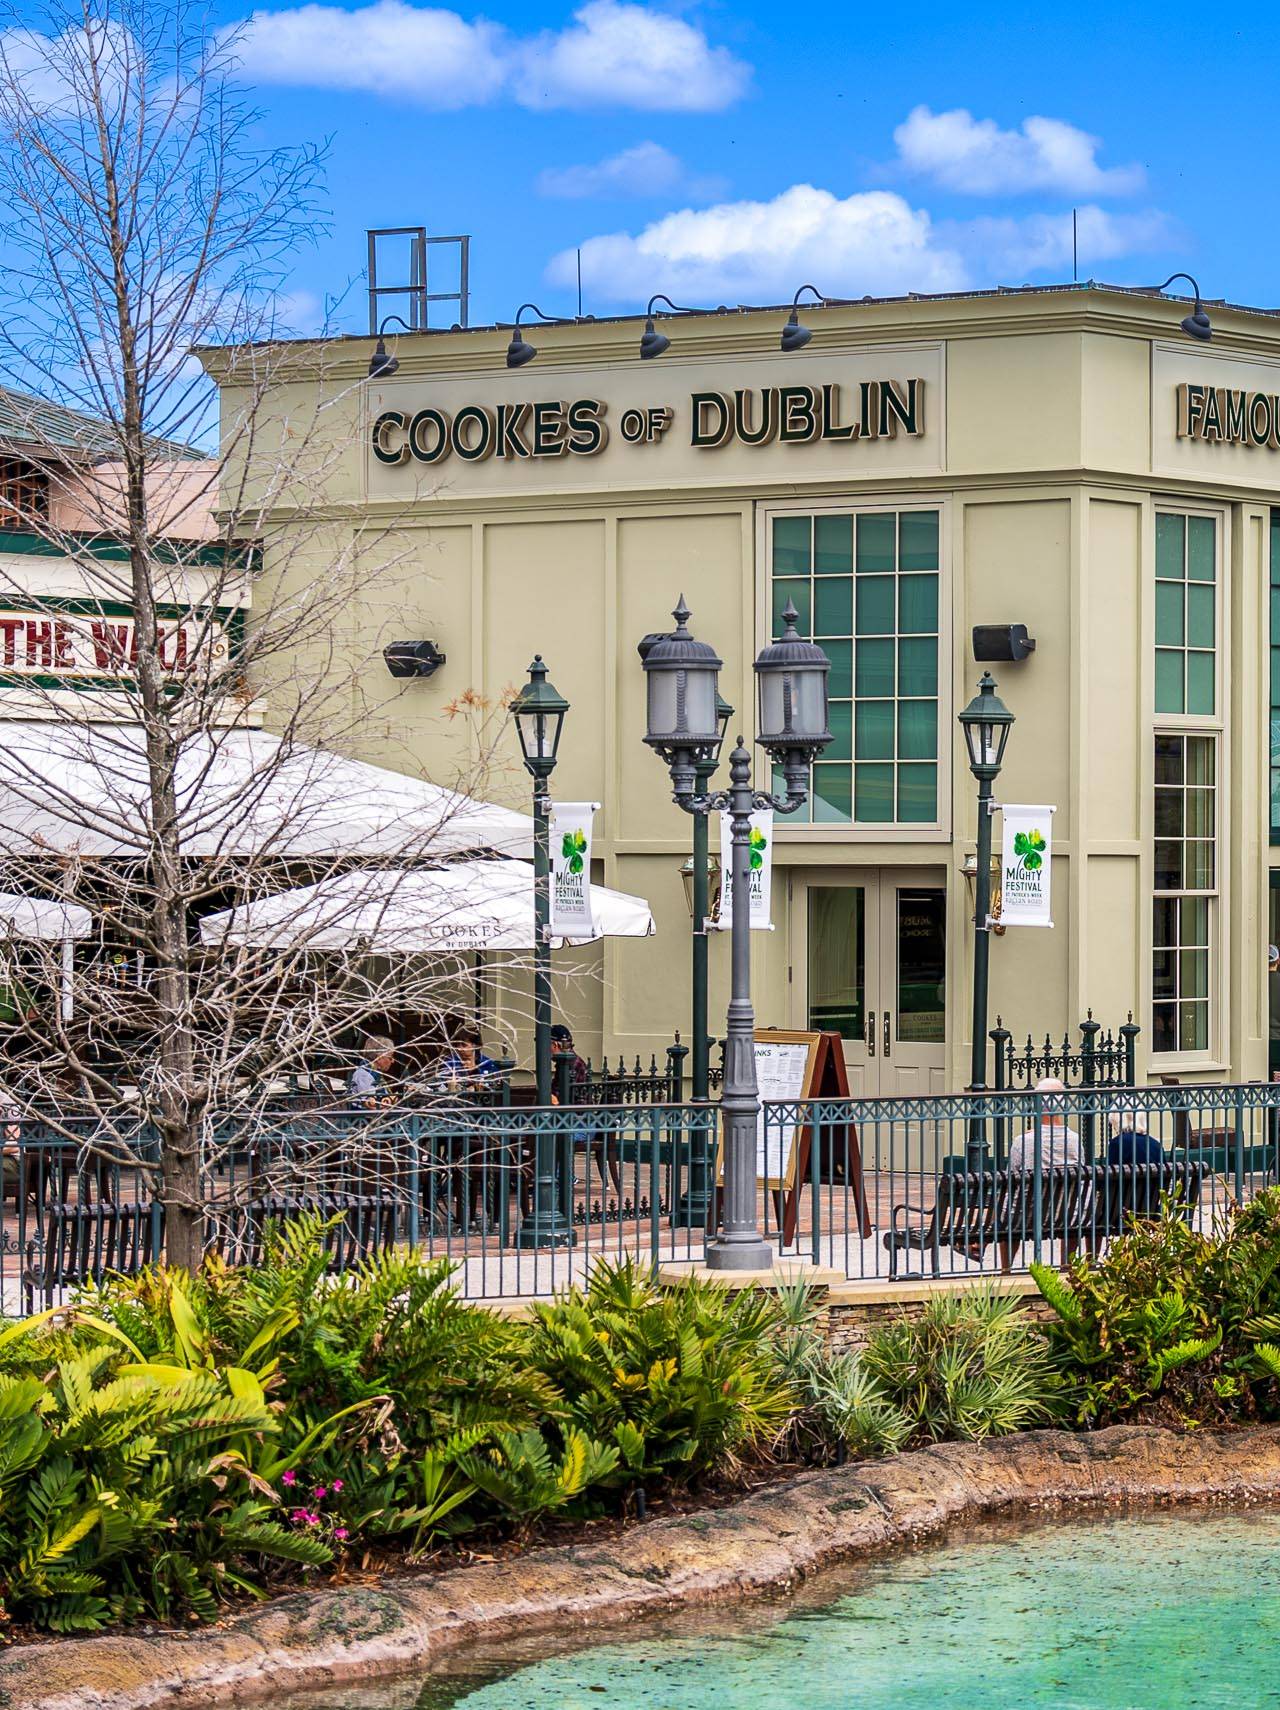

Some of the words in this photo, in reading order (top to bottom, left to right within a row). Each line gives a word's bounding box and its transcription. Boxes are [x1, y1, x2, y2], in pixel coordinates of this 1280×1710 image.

[371, 399, 606, 466] COOKES
[620, 406, 670, 444] OF
[690, 377, 924, 448] DUBLIN
[0, 619, 76, 668] THE
[90, 623, 197, 672] WLL
[555, 871, 583, 886] MIGHTY
[1006, 867, 1042, 880] MIGHTY
[555, 887, 584, 897] FESTIVAL
[1005, 881, 1042, 891] FESTIVAL
[429, 925, 502, 938] COOKES
